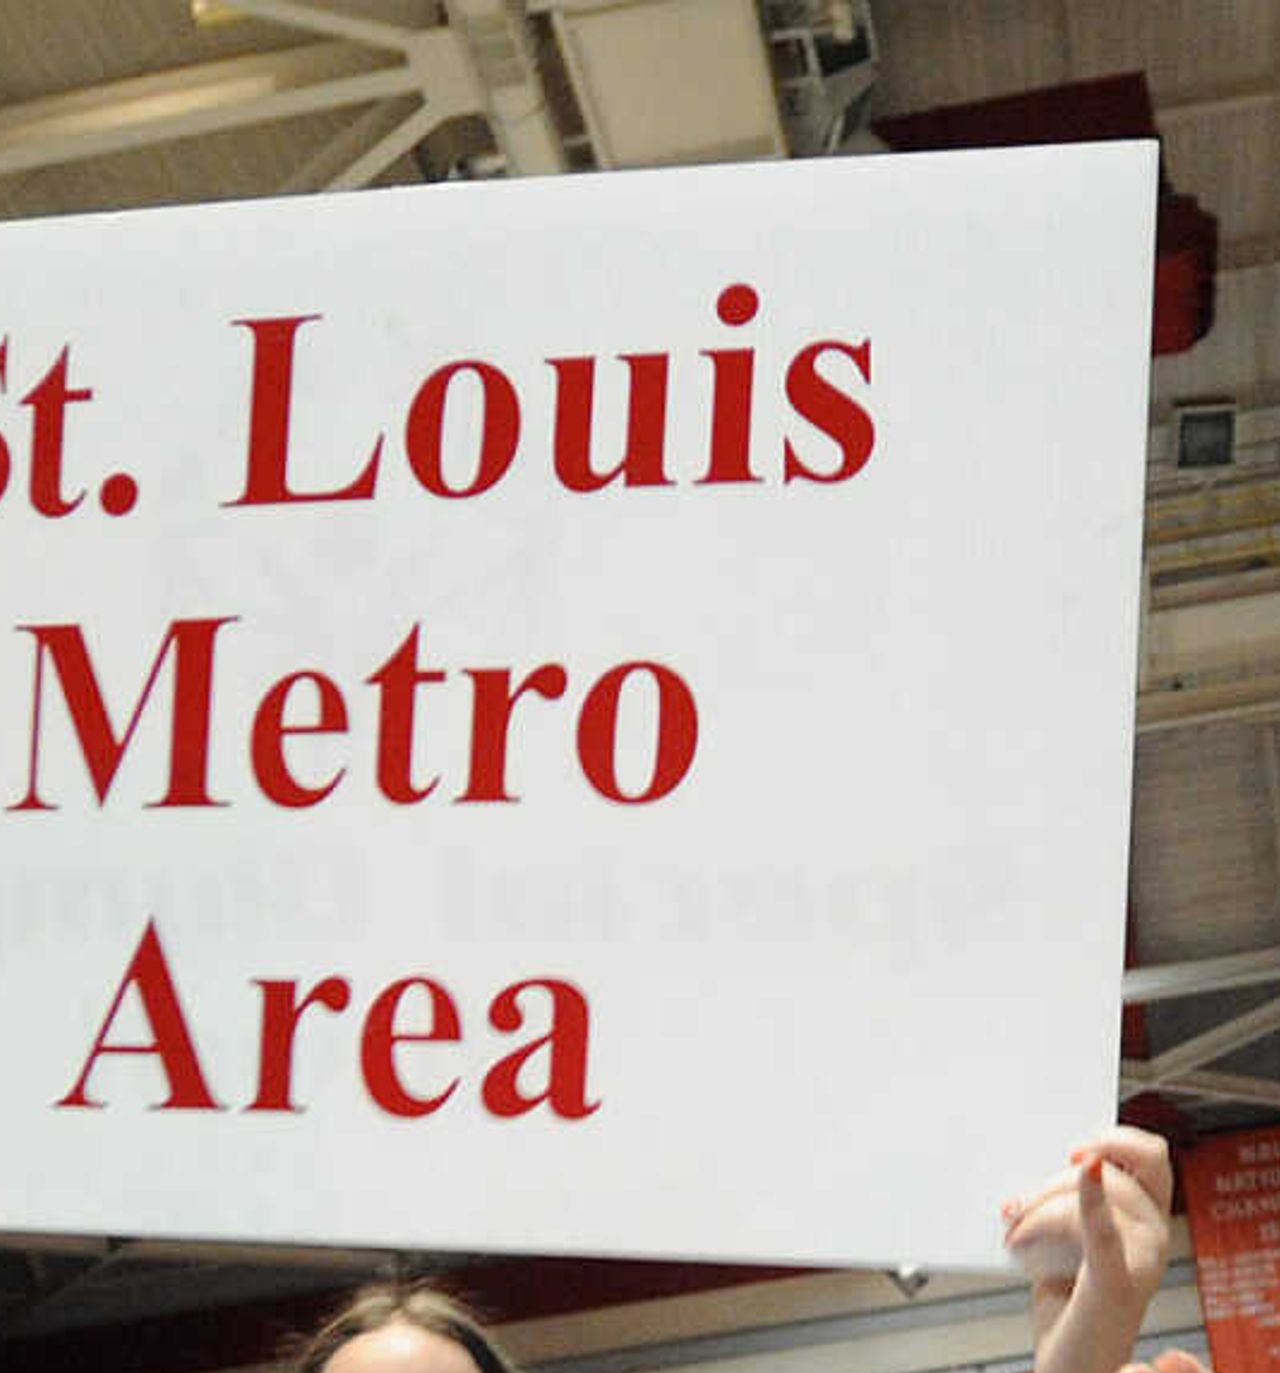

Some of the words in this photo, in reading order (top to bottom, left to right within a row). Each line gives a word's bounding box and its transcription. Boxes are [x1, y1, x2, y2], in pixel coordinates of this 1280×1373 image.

[220, 283, 877, 507] Louis
[4, 615, 700, 812] Metro
[54, 916, 602, 1122] Area
